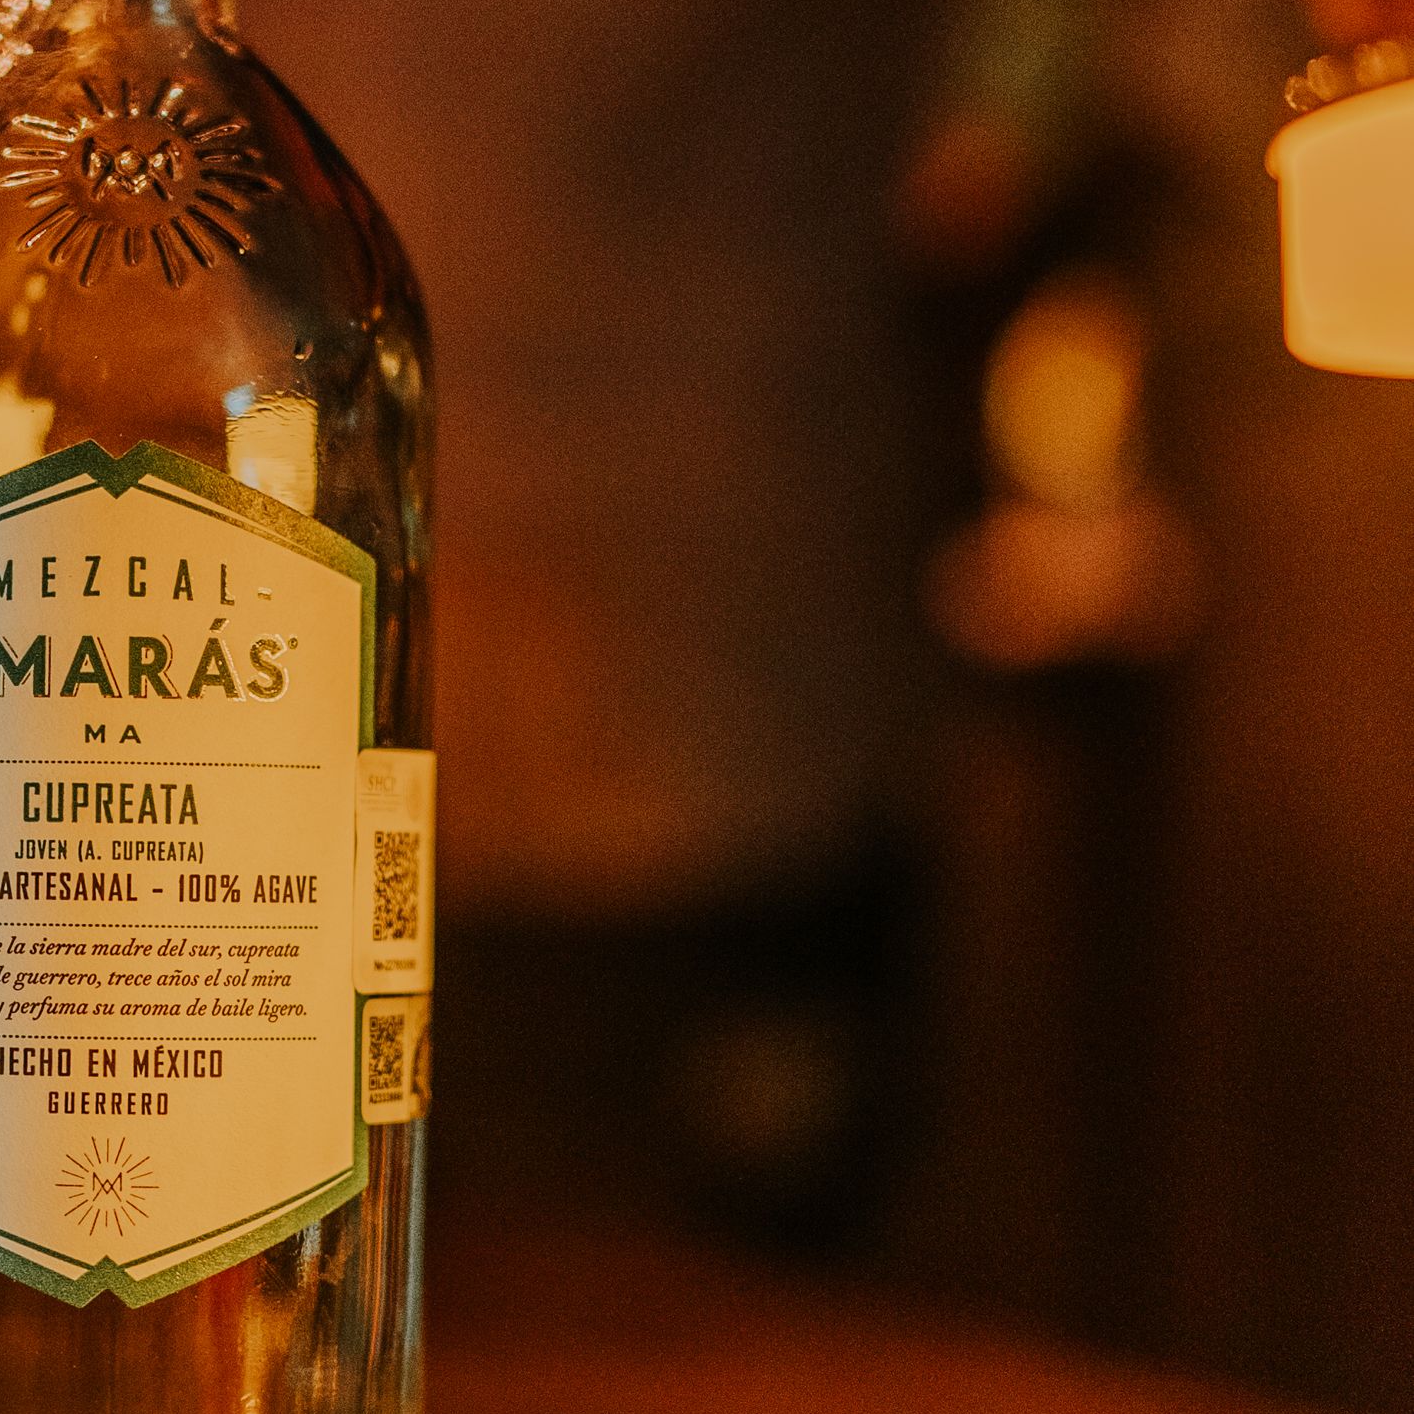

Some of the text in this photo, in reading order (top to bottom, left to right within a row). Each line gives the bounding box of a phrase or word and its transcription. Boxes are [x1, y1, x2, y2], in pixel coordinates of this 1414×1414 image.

[23, 782, 199, 825] CUPREATA
[15, 839, 204, 864] JOVEN (A. CUPREATA)
[178, 874, 241, 903] 100%
[253, 875, 317, 904] AGAVE
[7, 936, 26, 955] la
[29, 938, 86, 956] sierra
[91, 938, 153, 957] madre
[157, 939, 185, 958] del
[188, 943, 222, 960] sur,
[227, 943, 299, 963] cupreata
[13, 971, 102, 991] guerrero,
[107, 971, 152, 987] trece
[157, 968, 198, 987] años
[204, 969, 221, 987] el
[223, 969, 250, 987] sol
[252, 971, 291, 987] mira
[7, 996, 88, 1020] perfuma
[93, 1002, 115, 1016] su
[120, 1002, 181, 1017] aroma
[186, 998, 207, 1017] de
[211, 997, 254, 1017] baile
[258, 998, 307, 1023] ligero.
[88, 1049, 116, 1078] EN
[133, 1045, 223, 1078] MÉXICO
[48, 1091, 168, 1116] GUERRERO
